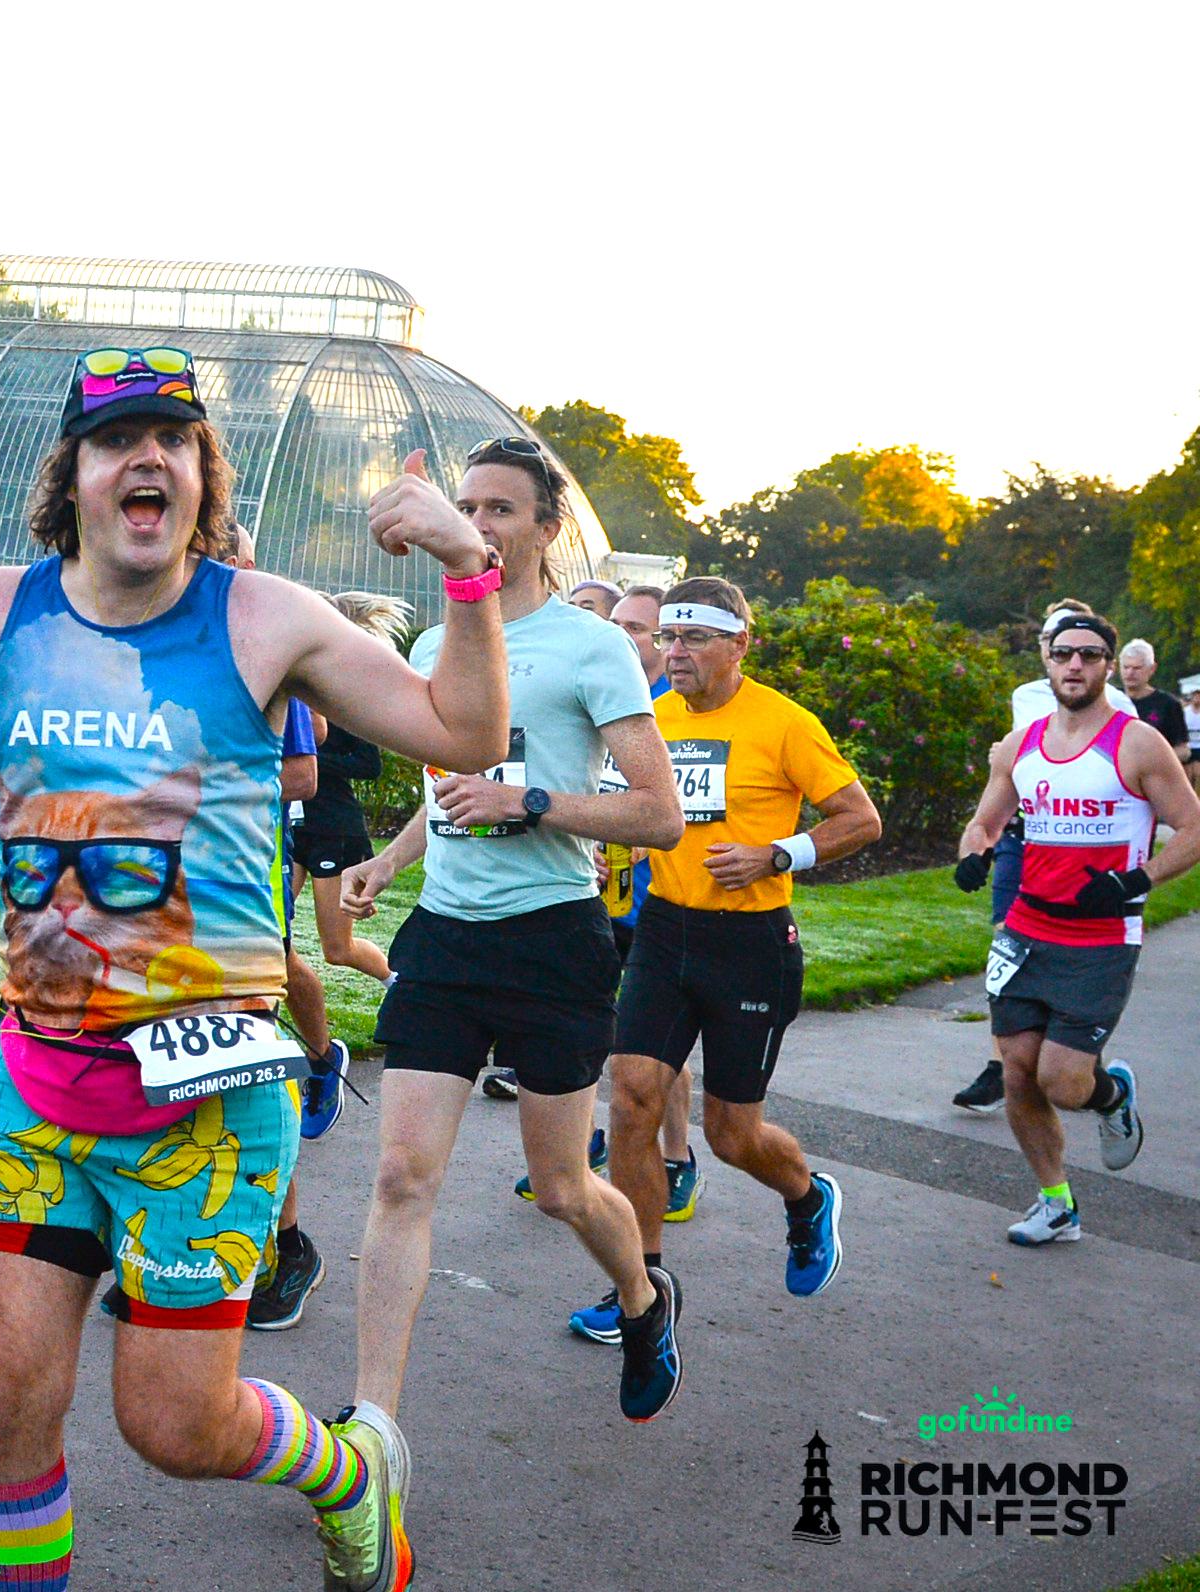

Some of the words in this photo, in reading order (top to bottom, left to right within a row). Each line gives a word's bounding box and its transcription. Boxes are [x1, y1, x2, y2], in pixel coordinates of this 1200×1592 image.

[8, 710, 173, 751] ARENA
[669, 748, 711, 759] ofundme
[1054, 822, 1115, 835] cancer
[168, 1071, 253, 1102] RICHMOND
[255, 1064, 287, 1083] 26.2
